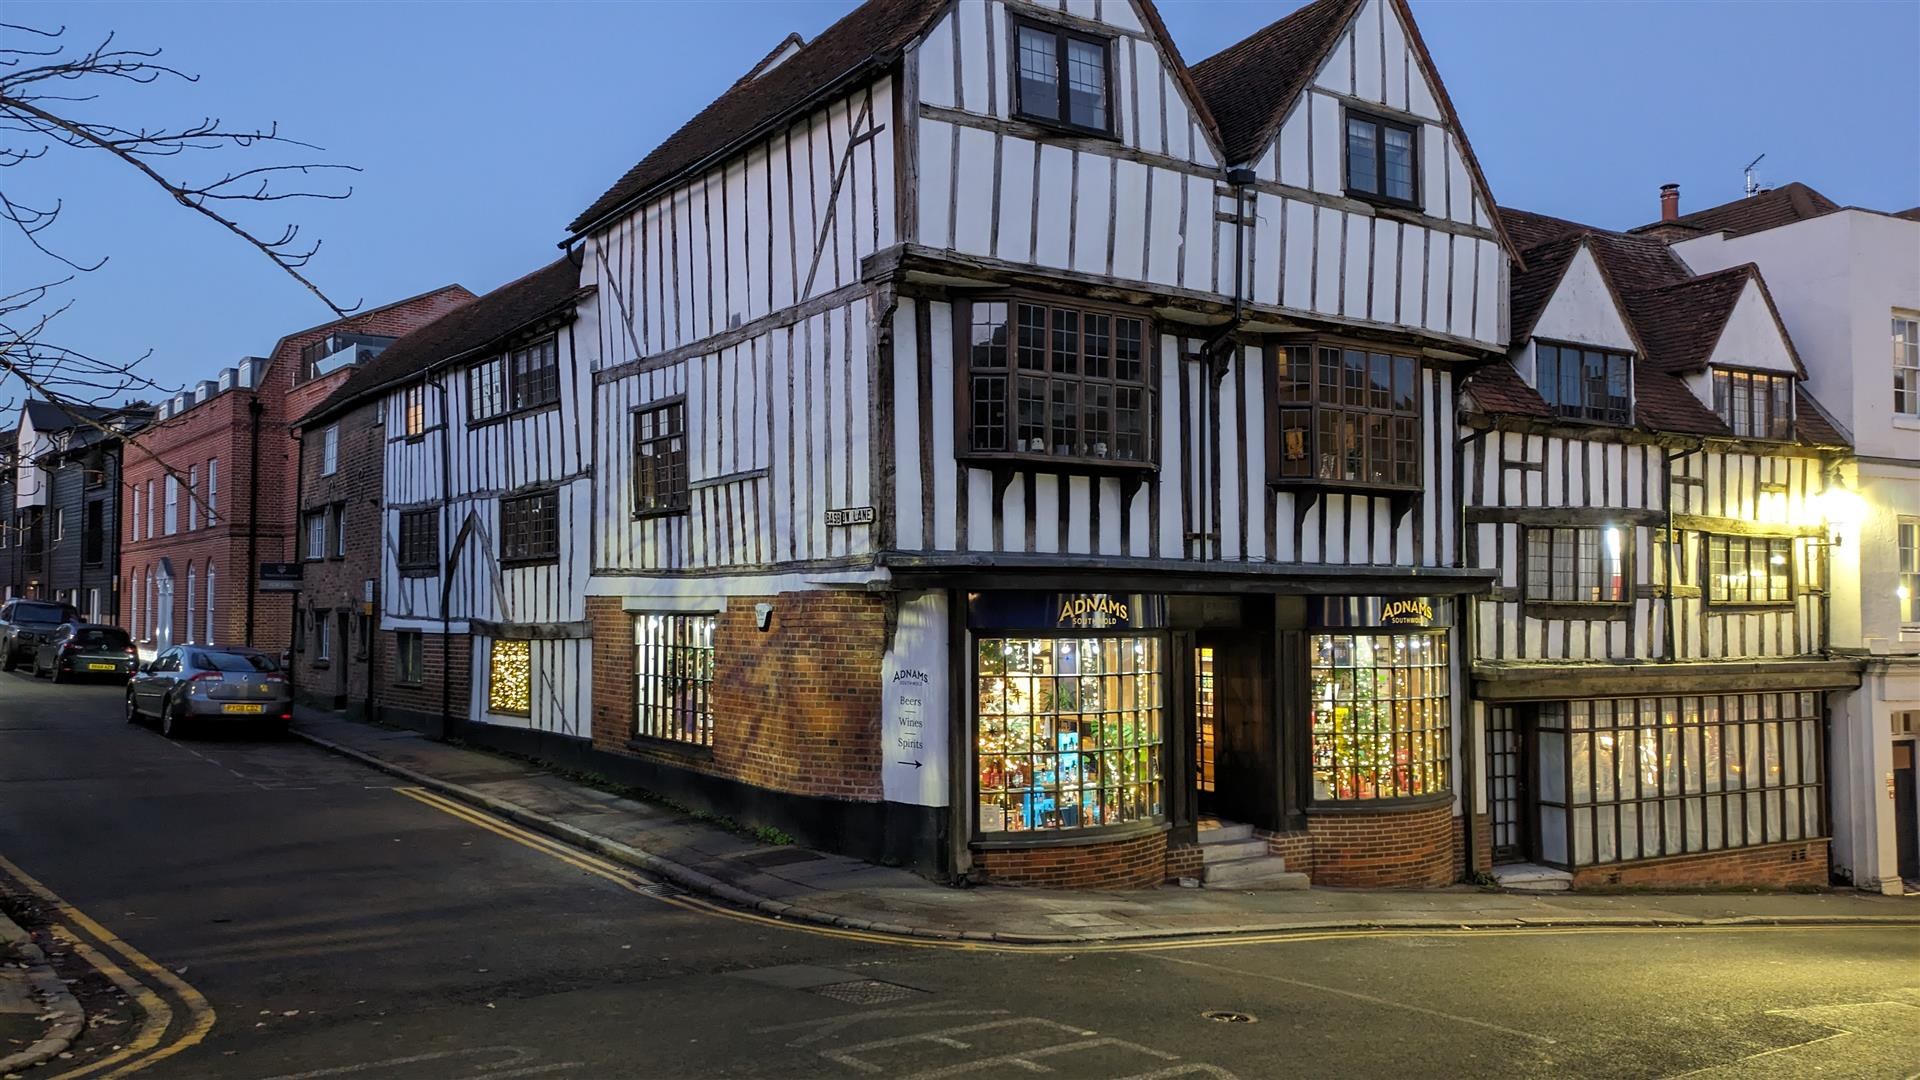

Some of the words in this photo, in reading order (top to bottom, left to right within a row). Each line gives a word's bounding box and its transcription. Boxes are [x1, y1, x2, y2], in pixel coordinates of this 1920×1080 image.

[853, 510, 872, 522] LANE
[893, 670, 928, 683] ADNAMS
[900, 696, 922, 707] Beers
[899, 717, 923, 728] Wines
[898, 738, 923, 750] Spirits
